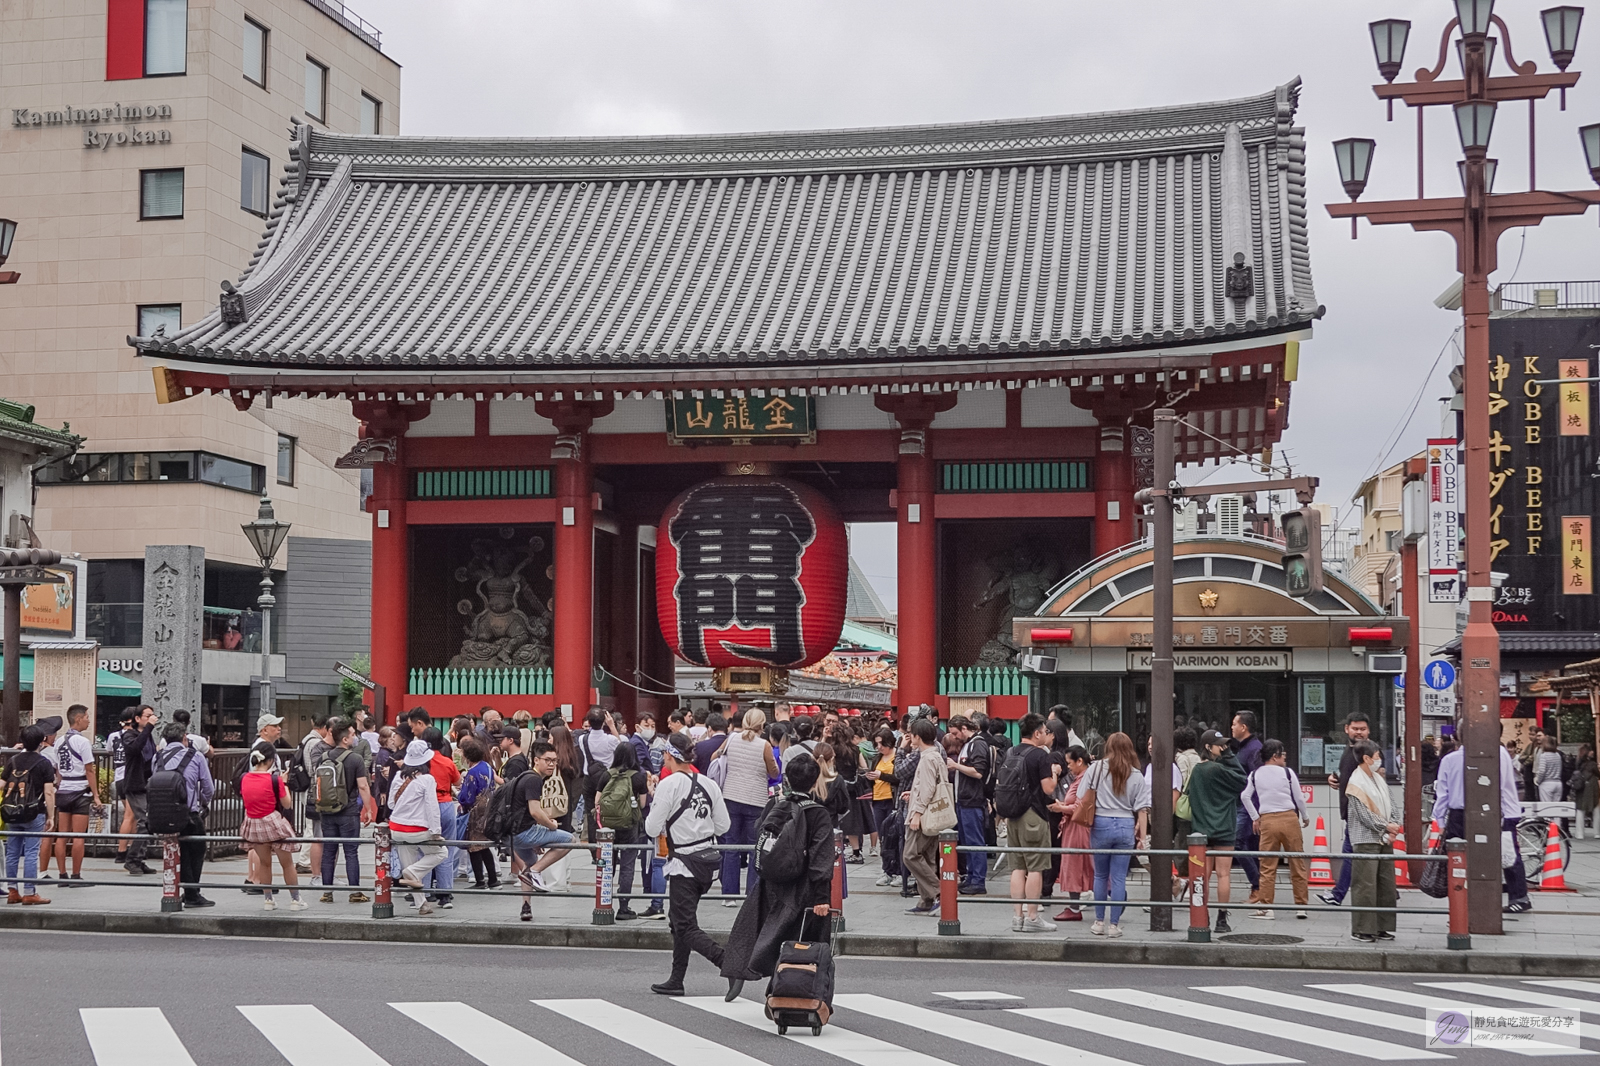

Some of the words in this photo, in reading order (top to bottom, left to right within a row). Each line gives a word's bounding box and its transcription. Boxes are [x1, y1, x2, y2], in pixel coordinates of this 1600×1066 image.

[12, 102, 172, 128] Kaminarimon
[83, 126, 171, 152] Ryokan
[1524, 356, 1542, 444] KOBE
[1566, 366, 1582, 428] 鉄板焼
[1444, 448, 1456, 504] KOBE
[1525, 466, 1543, 555] BEEF
[1445, 511, 1457, 567] BEEF
[1570, 521, 1584, 587] 雷門東店
[669, 480, 816, 666] 雷門
[1130, 633, 1195, 646] 浅草察署
[1200, 625, 1288, 645] 雷門交番
[1141, 656, 1229, 667] KNARIMON
[1236, 656, 1279, 667] KOBAN
